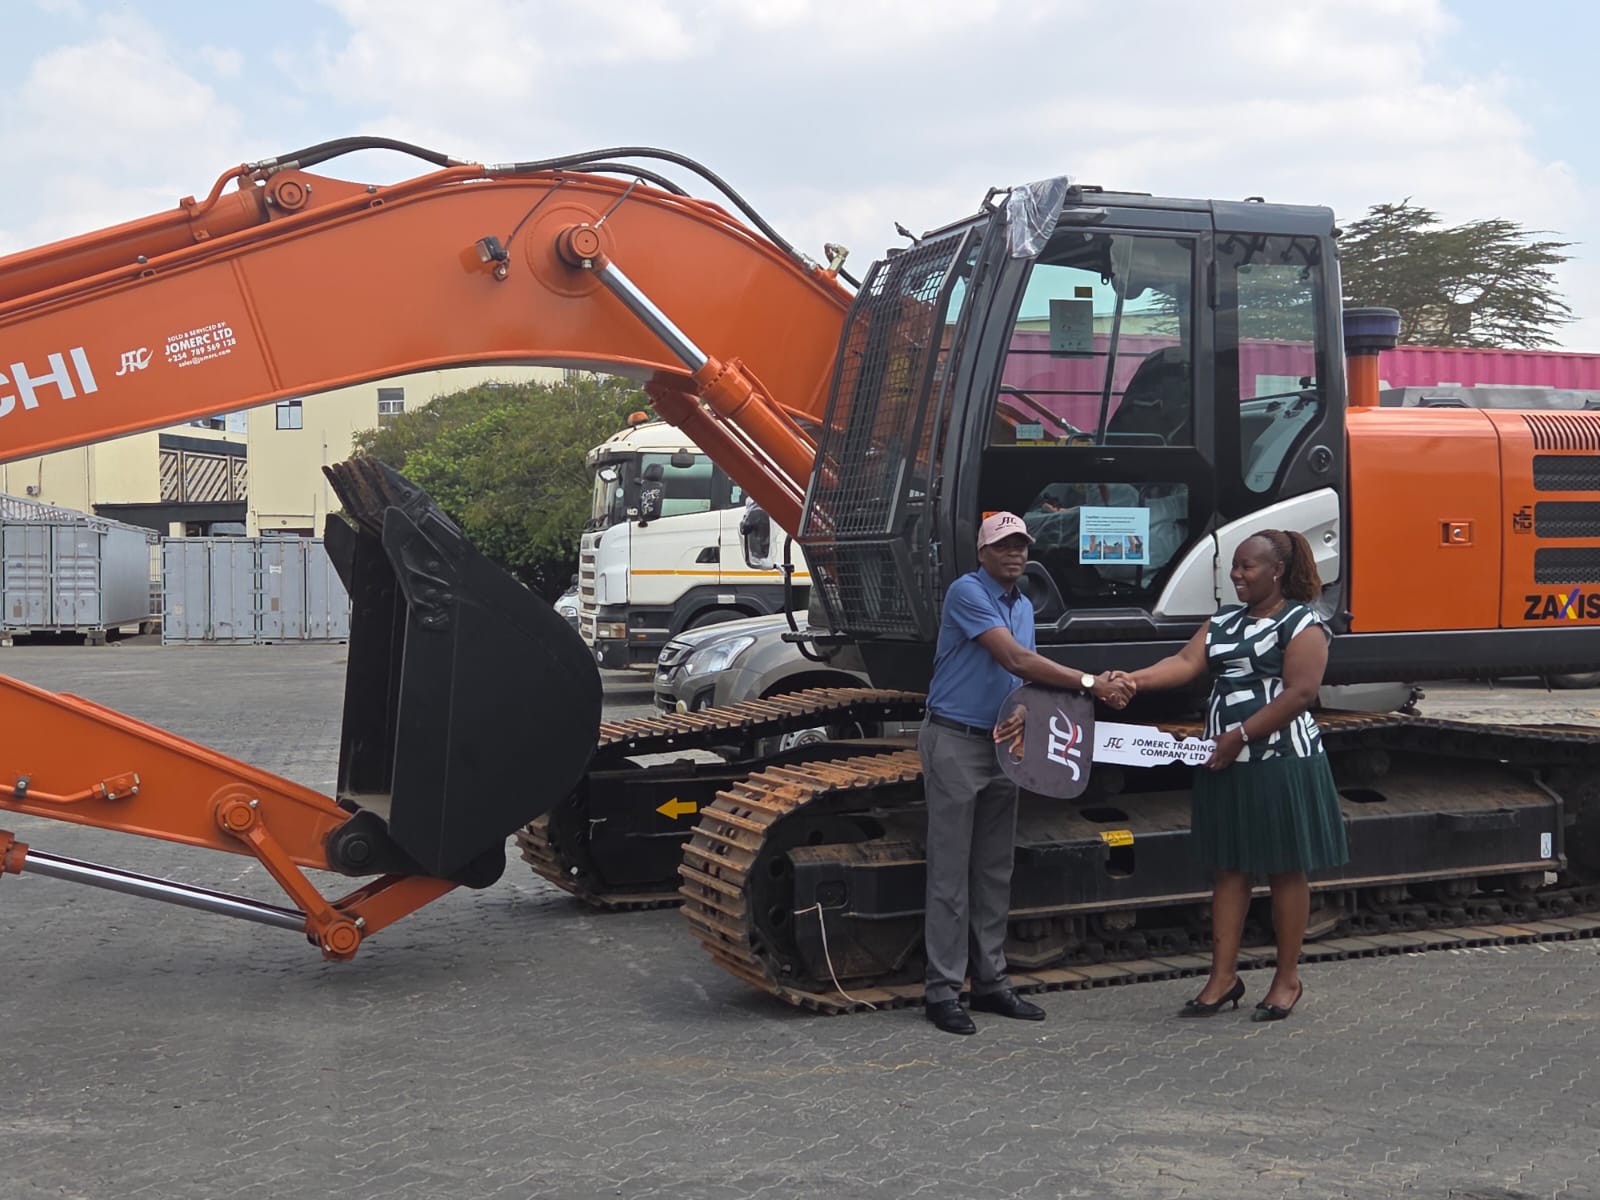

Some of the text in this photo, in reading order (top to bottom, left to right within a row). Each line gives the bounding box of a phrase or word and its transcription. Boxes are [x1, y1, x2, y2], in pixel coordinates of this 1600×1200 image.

[165, 327, 233, 355] JOMERC LTD
[167, 333, 184, 343] SOLD
[189, 324, 217, 337] SERVICED
[115, 347, 153, 376] JTC
[167, 352, 187, 363] +254
[191, 346, 205, 357] 789
[223, 338, 237, 347] 128
[998, 516, 1017, 527] JTC
[1524, 588, 1600, 620] ZAXIS
[1047, 706, 1083, 782] JTC
[1103, 737, 1124, 749] JTC
[1131, 738, 1216, 753] JOMERC TRADING
[1140, 748, 1206, 761] COMPANY LTD
